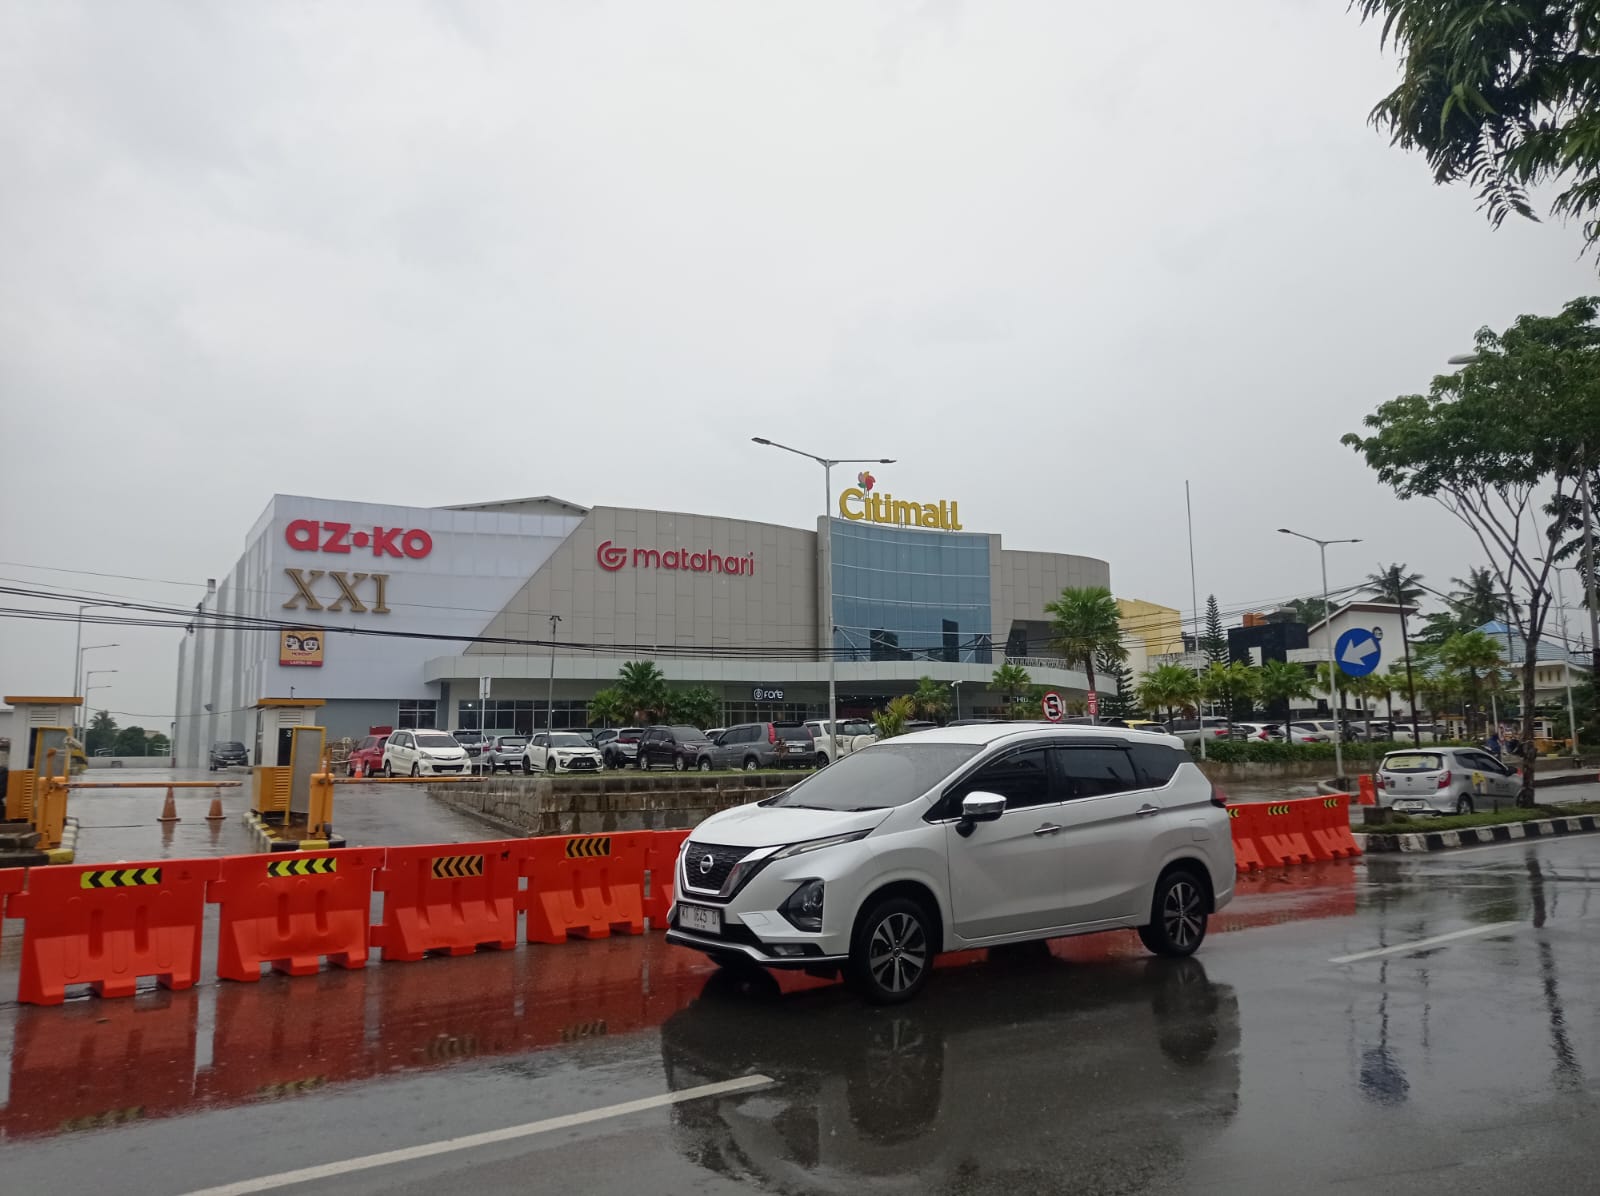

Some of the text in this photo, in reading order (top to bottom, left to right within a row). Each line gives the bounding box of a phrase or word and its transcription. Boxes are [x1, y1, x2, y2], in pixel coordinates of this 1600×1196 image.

[839, 488, 962, 530] Citimall
[632, 548, 754, 576] matahari
[282, 568, 391, 613] XXI
